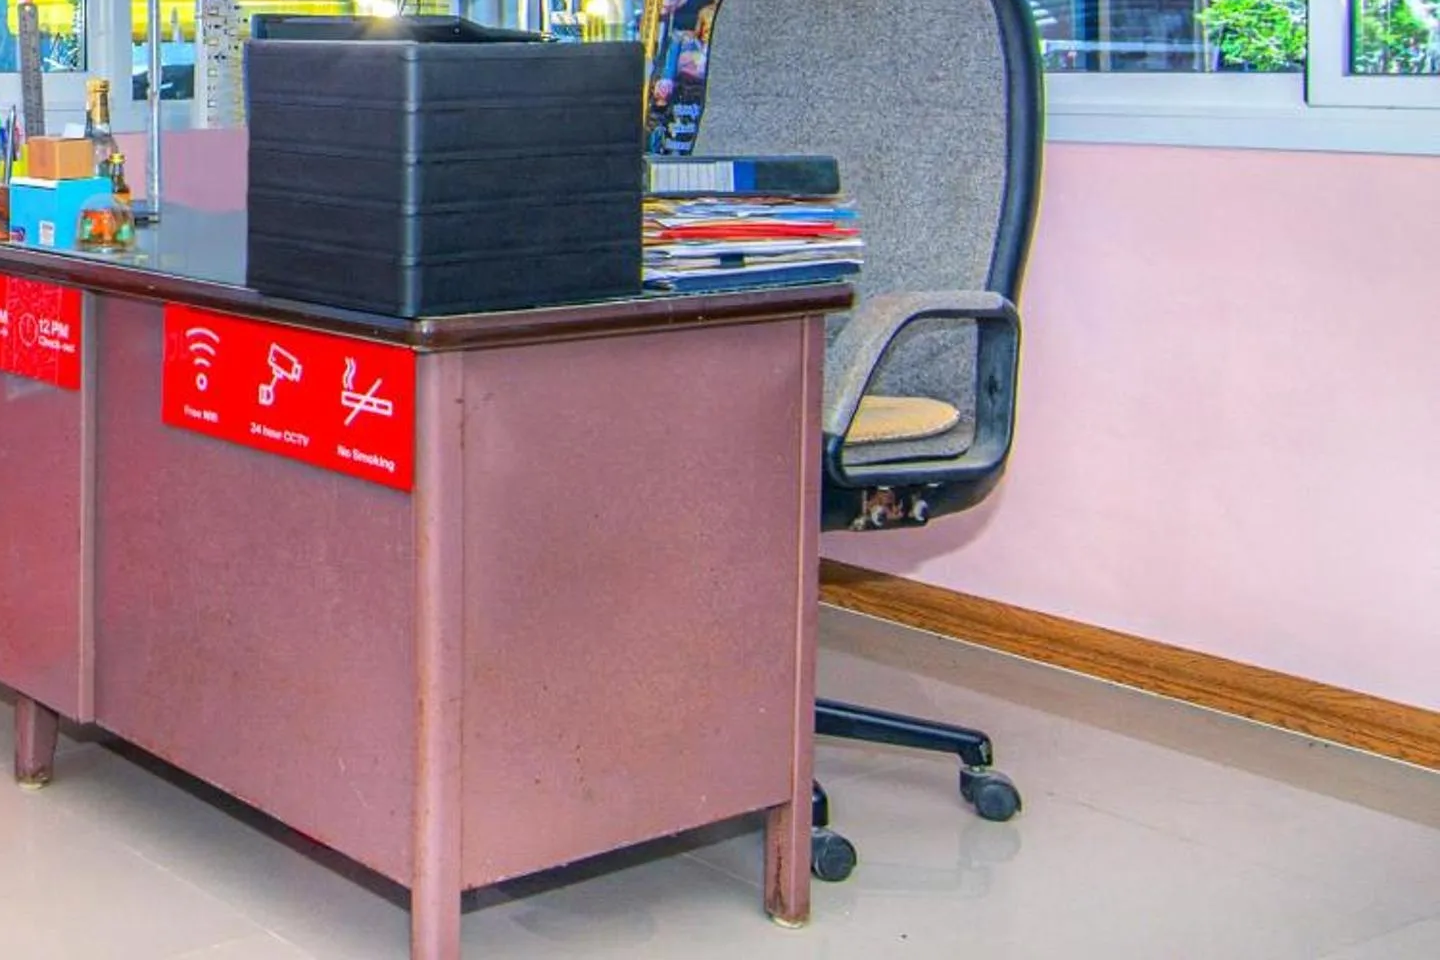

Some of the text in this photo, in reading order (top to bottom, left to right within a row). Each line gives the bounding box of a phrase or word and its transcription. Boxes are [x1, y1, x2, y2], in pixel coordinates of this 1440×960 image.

[51, 319, 70, 340] PM
[337, 444, 396, 473] No Smoking
